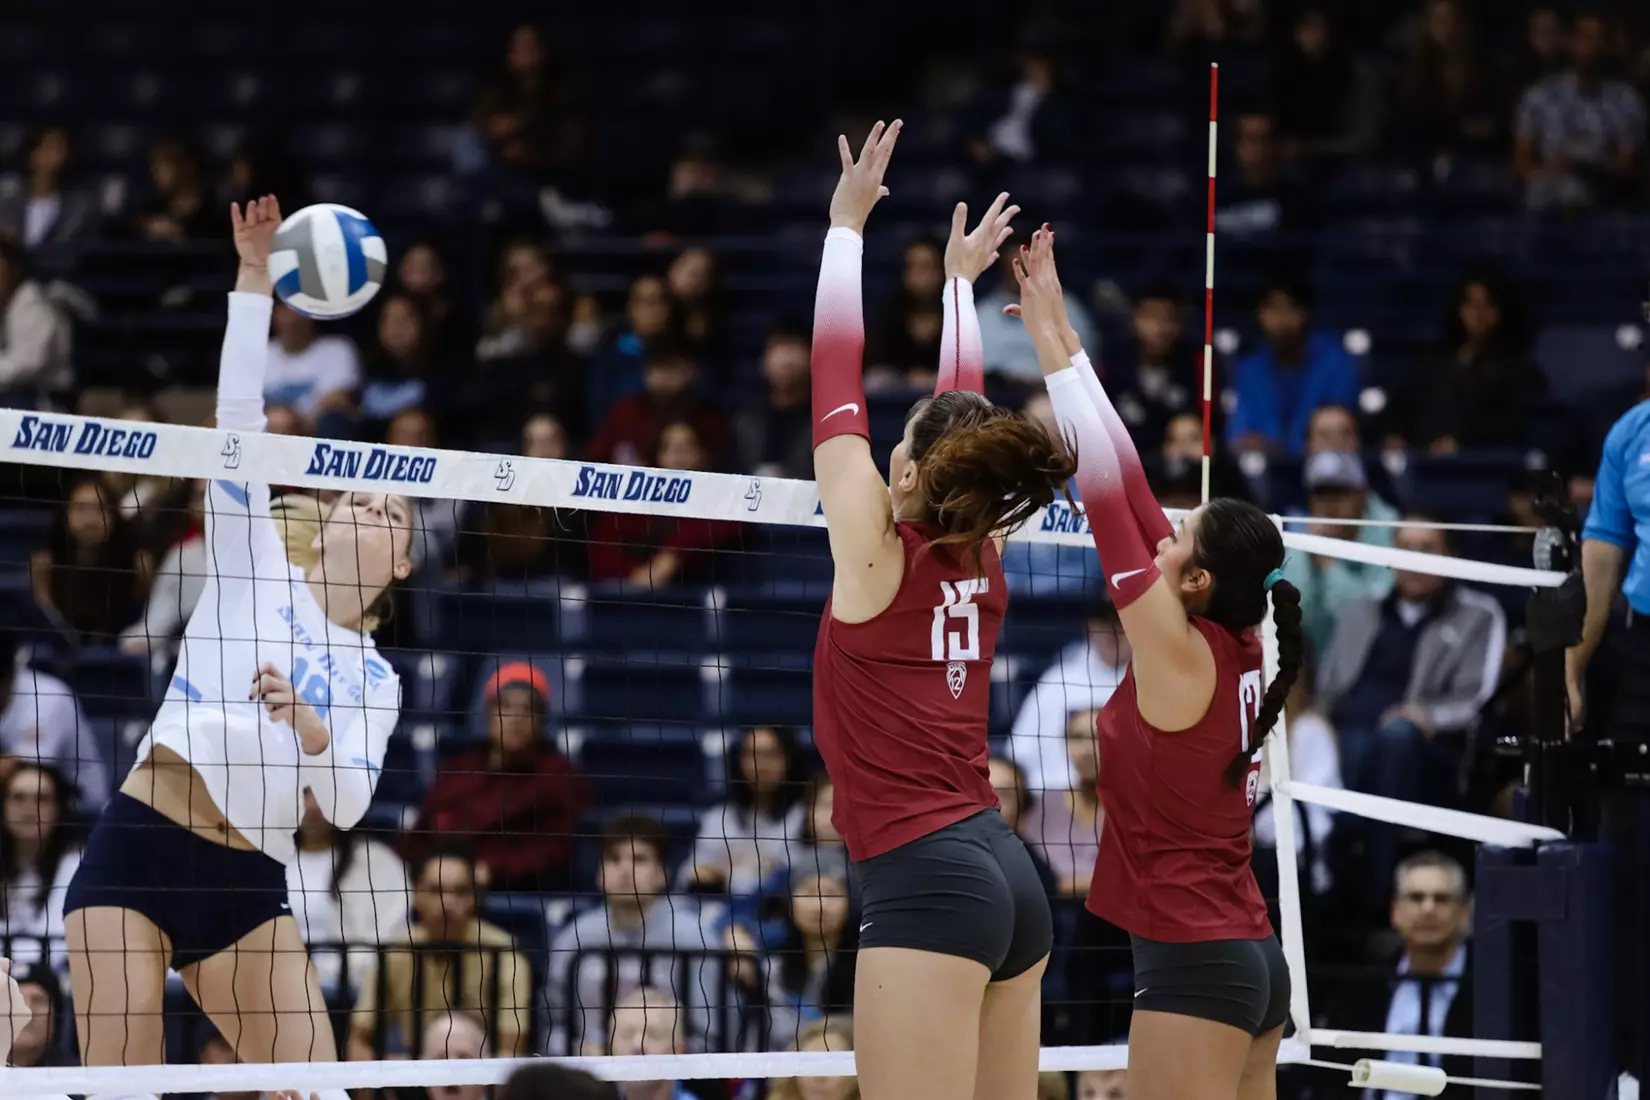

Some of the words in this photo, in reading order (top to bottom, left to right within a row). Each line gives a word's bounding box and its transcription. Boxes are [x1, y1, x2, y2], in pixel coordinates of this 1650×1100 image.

[11, 415, 73, 452] SAN
[73, 422, 158, 460] DIEGO
[304, 443, 364, 478] SAN
[361, 448, 438, 483] DIEGO
[571, 466, 625, 499] SAN
[621, 472, 693, 504] DIEGO
[1040, 504, 1084, 535] SAN
[931, 577, 989, 660] 15
